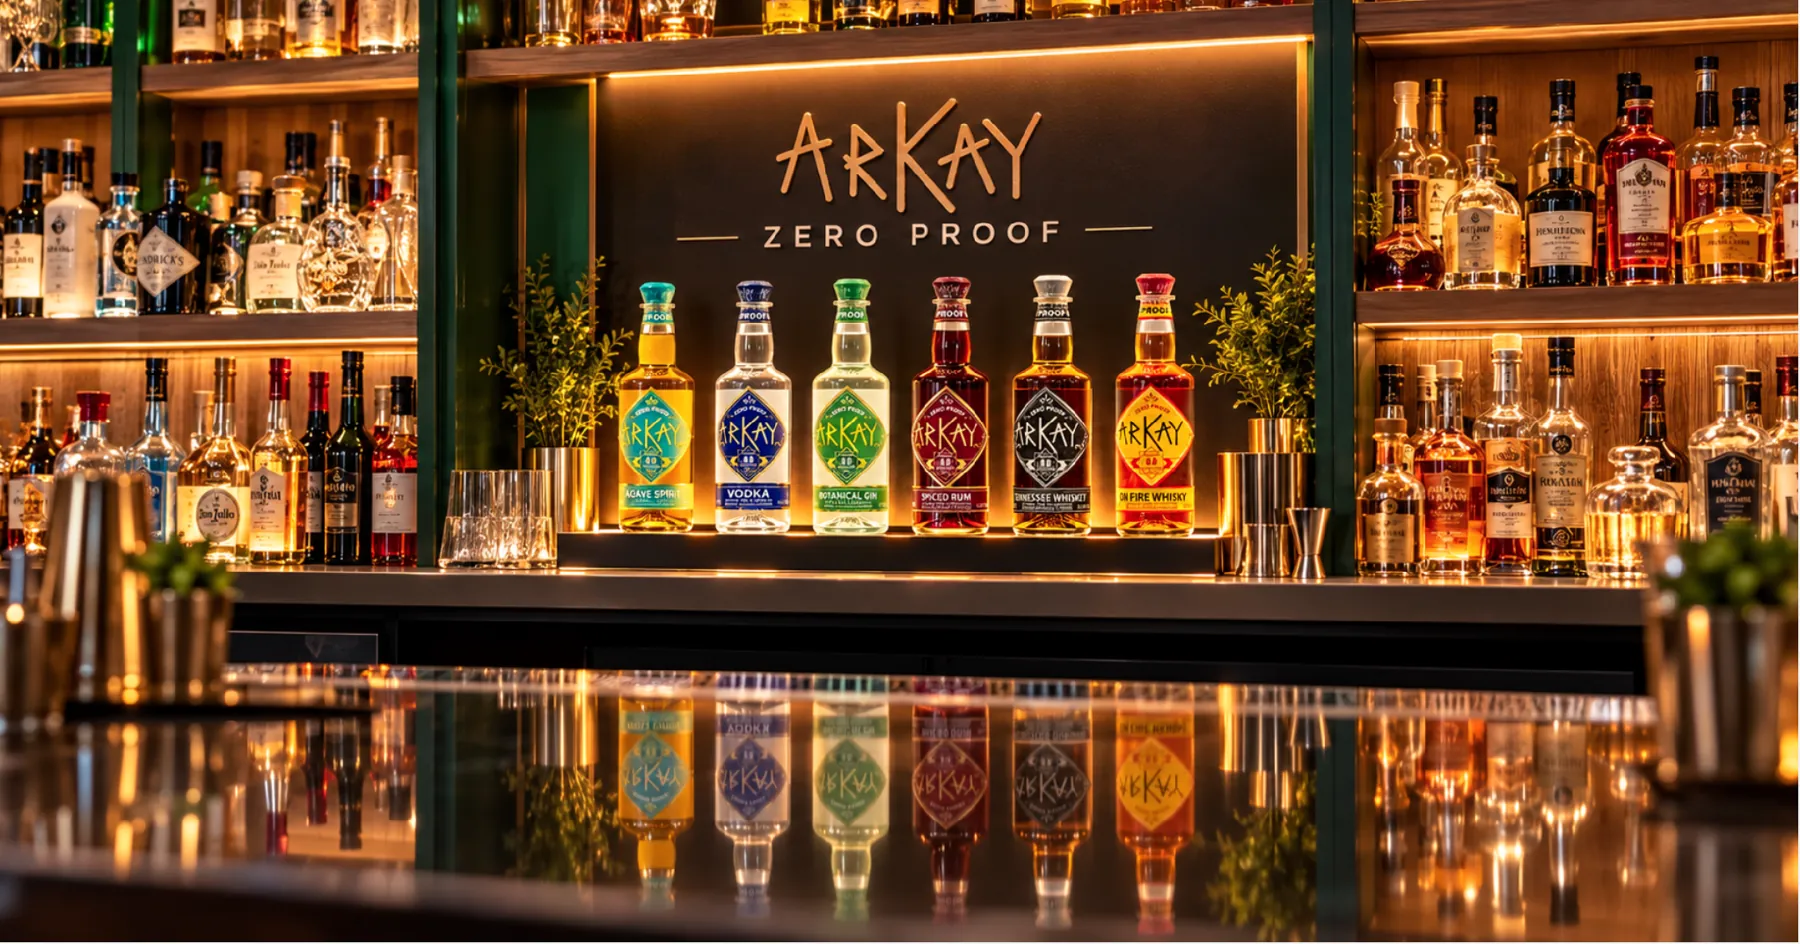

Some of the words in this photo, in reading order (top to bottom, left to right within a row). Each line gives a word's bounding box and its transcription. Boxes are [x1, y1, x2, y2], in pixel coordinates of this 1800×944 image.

[763, 223, 879, 249] ZERO
[910, 220, 1060, 246] PROOF
[727, 488, 770, 499] VODKA
[950, 492, 972, 502] RUM
[1129, 492, 1150, 502] FIRE
[1151, 492, 1187, 502] WHISKY
